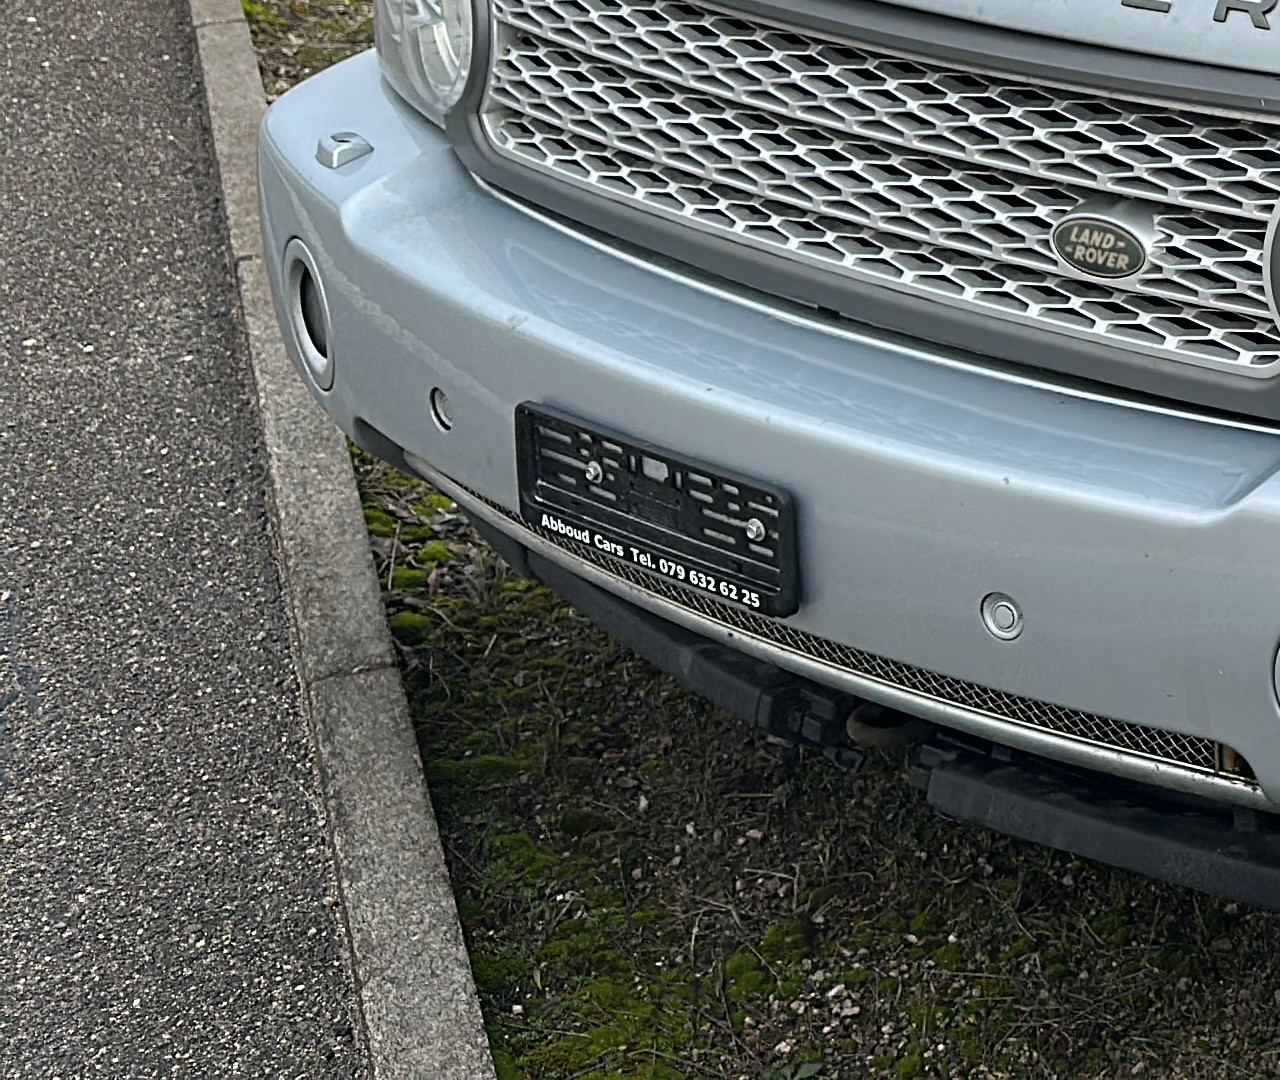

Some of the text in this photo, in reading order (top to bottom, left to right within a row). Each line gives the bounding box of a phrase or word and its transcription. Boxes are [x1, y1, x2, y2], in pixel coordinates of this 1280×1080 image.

[1070, 226, 1116, 249] LAND
[1073, 244, 1130, 270] ROVER
[541, 513, 761, 608] Abboud Cars Tel. 079 632 62 25
